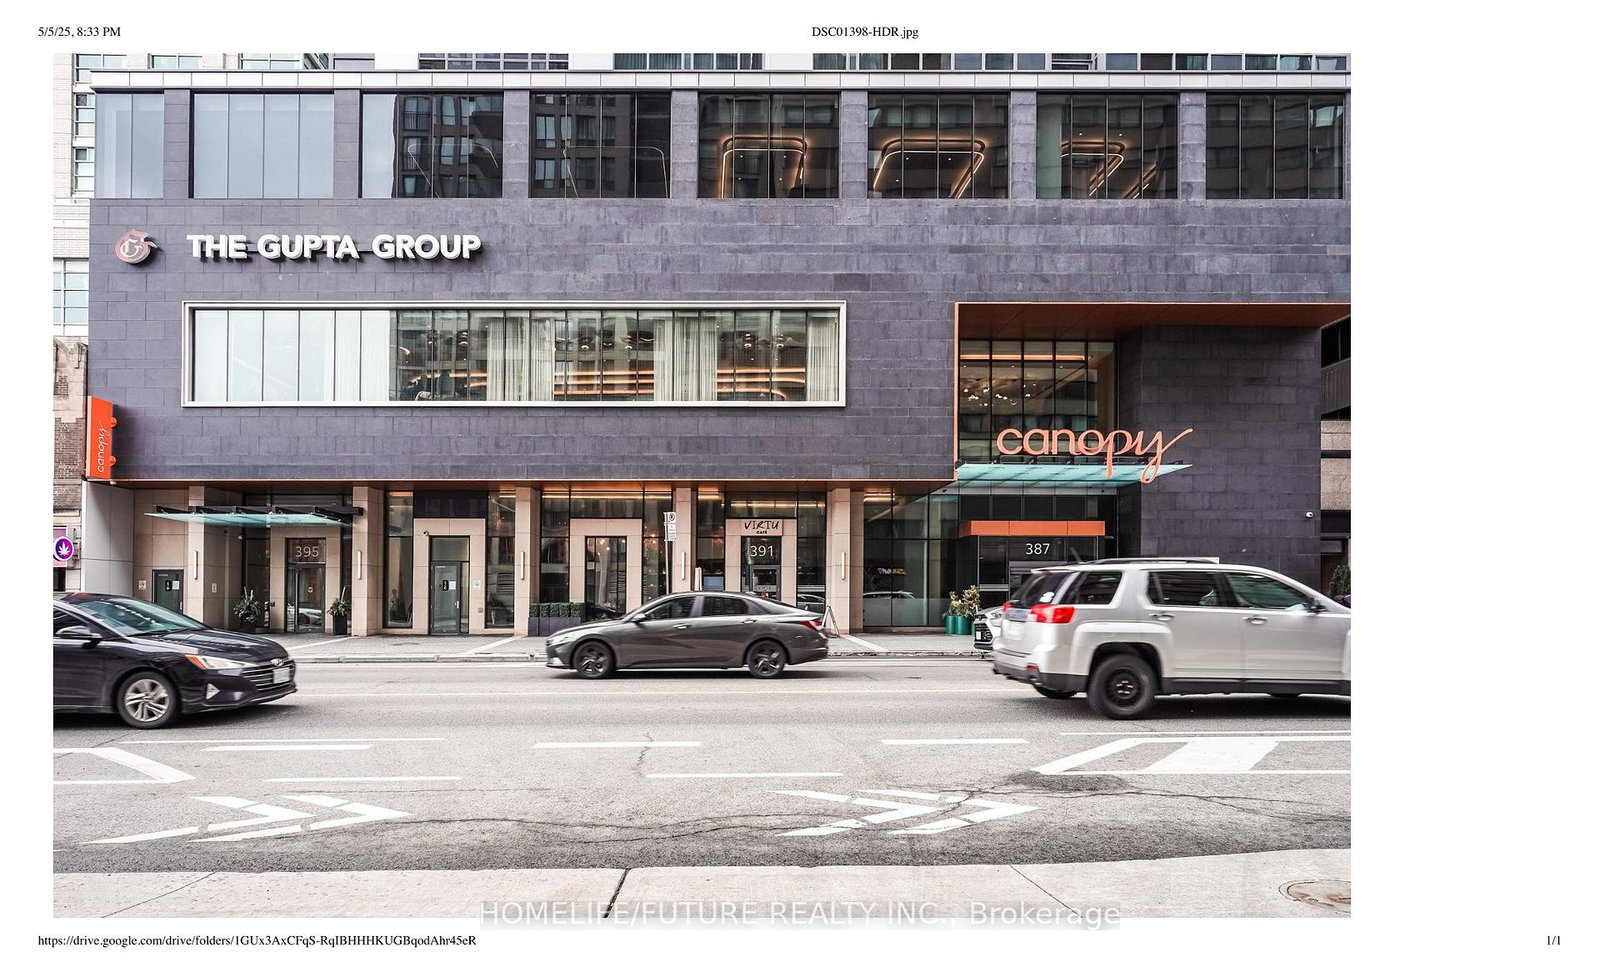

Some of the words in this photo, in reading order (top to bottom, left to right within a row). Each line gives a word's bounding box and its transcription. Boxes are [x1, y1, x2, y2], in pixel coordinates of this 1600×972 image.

[186, 234, 248, 259] THE
[257, 234, 360, 259] GUPTA
[372, 234, 482, 259] GROUP
[97, 420, 112, 473] canopy
[996, 427, 1194, 484] canopy
[744, 520, 780, 530] VIRTU
[295, 545, 320, 558] 395
[749, 545, 774, 557] 391
[1025, 543, 1051, 555] 387
